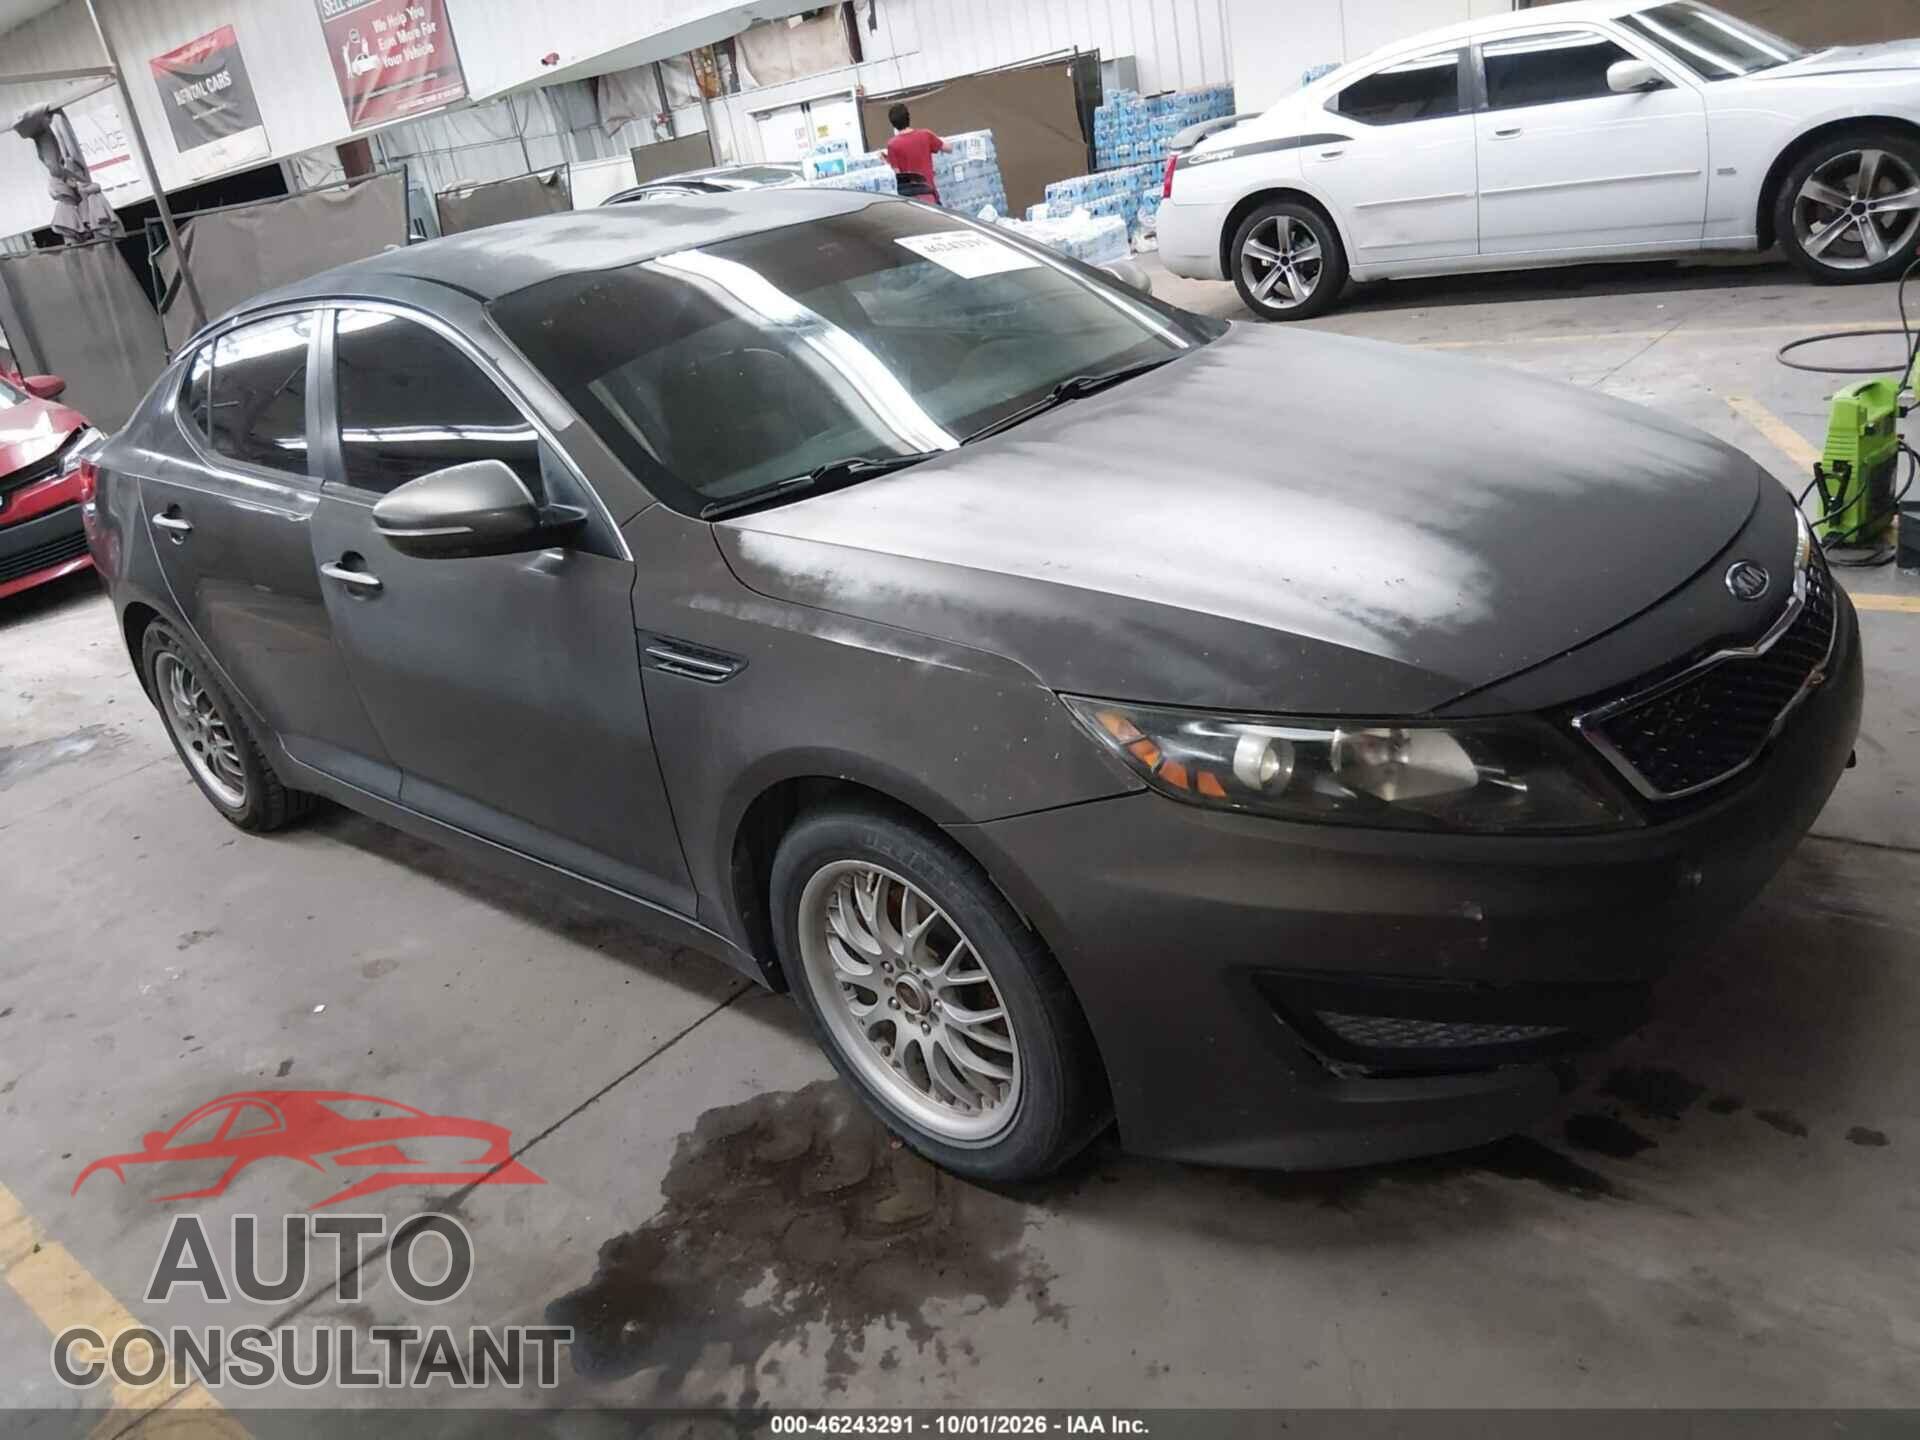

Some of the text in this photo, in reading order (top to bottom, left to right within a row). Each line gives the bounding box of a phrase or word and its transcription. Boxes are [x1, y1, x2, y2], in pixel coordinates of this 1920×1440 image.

[387, 11, 407, 28] Help
[406, 5, 425, 19] You
[397, 27, 421, 43] More
[420, 22, 437, 36] For
[382, 54, 402, 68] Your
[173, 70, 232, 106] RENTAL CARS
